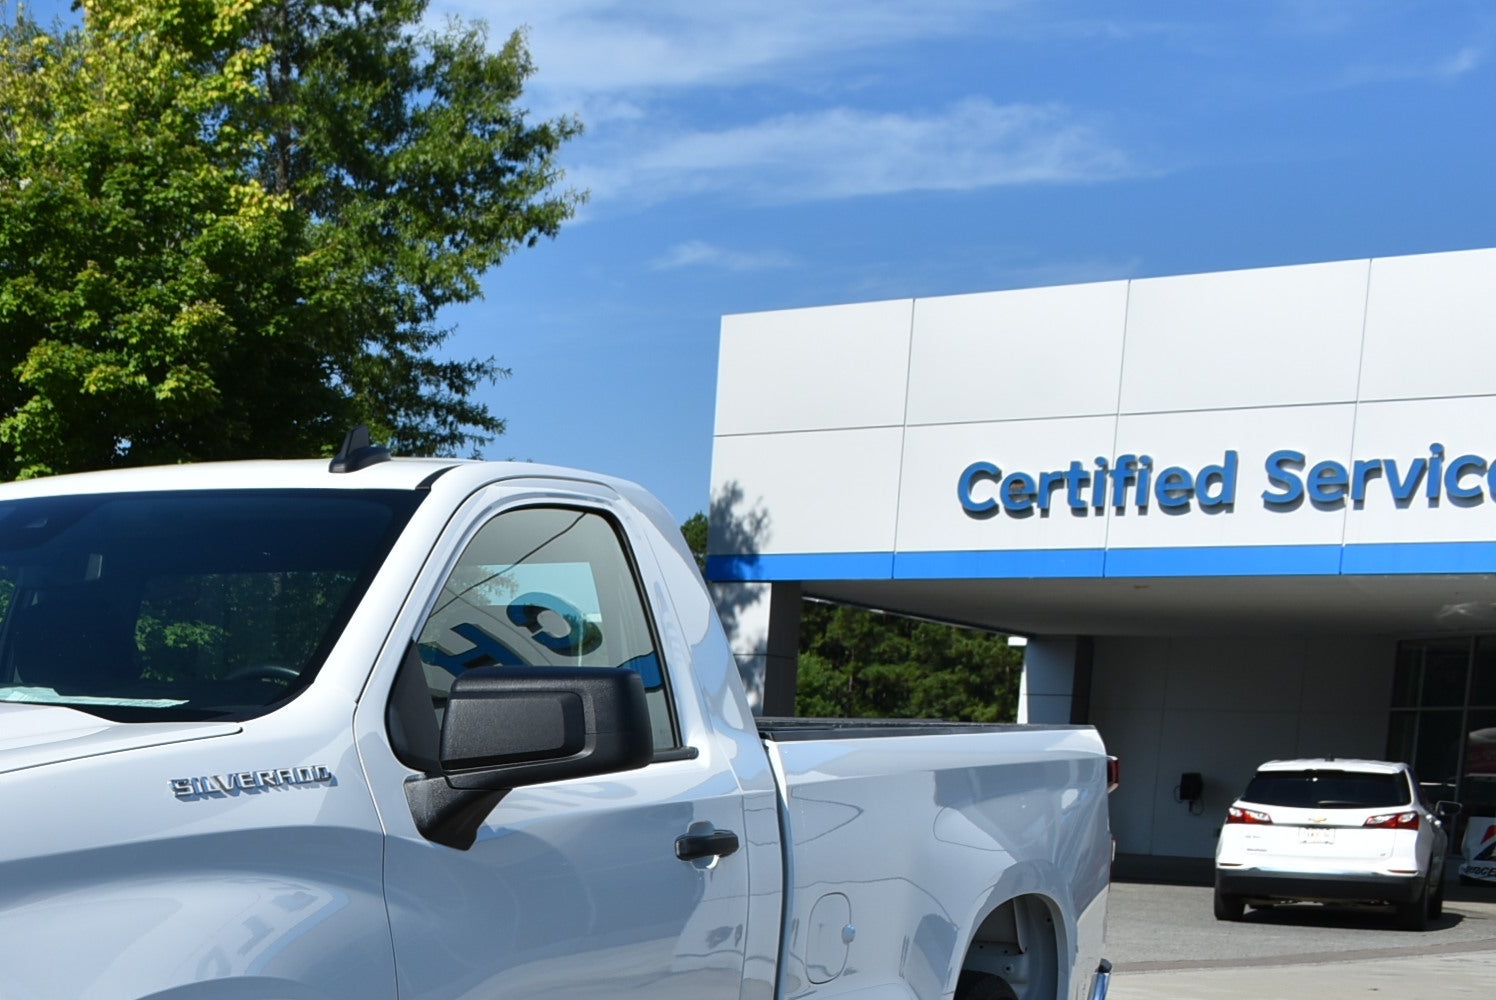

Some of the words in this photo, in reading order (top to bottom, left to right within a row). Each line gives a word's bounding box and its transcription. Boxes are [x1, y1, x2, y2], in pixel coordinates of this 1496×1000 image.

[956, 447, 1238, 516] Certified
[1261, 442, 1496, 510] Servic
[168, 765, 333, 798] SILVERADO
